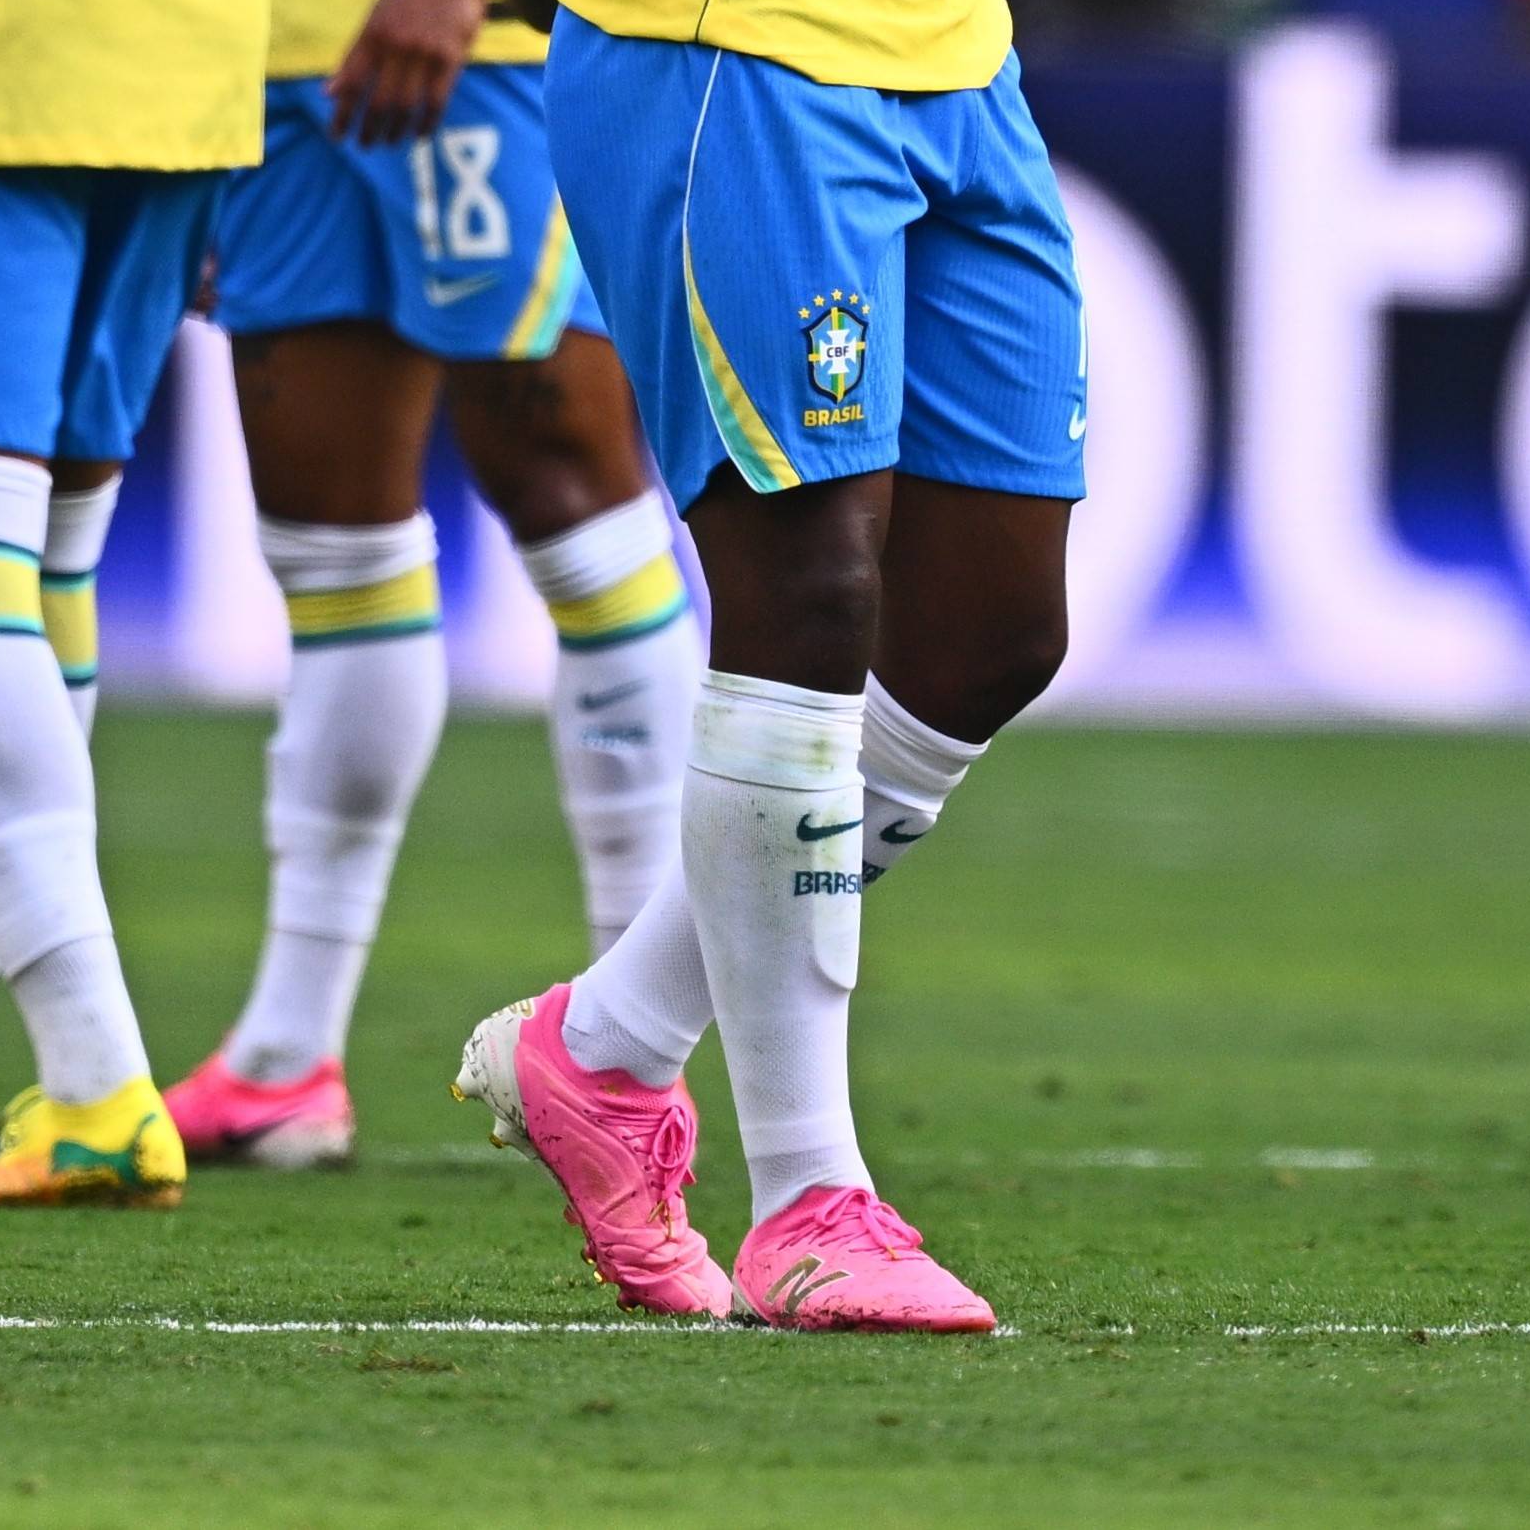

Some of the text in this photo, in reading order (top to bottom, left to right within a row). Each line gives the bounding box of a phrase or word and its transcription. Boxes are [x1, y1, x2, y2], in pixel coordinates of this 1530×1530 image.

[412, 124, 512, 262] 18
[826, 345, 850, 358] CBF
[803, 403, 865, 427] BRASIL
[794, 871, 862, 896] BRASI
